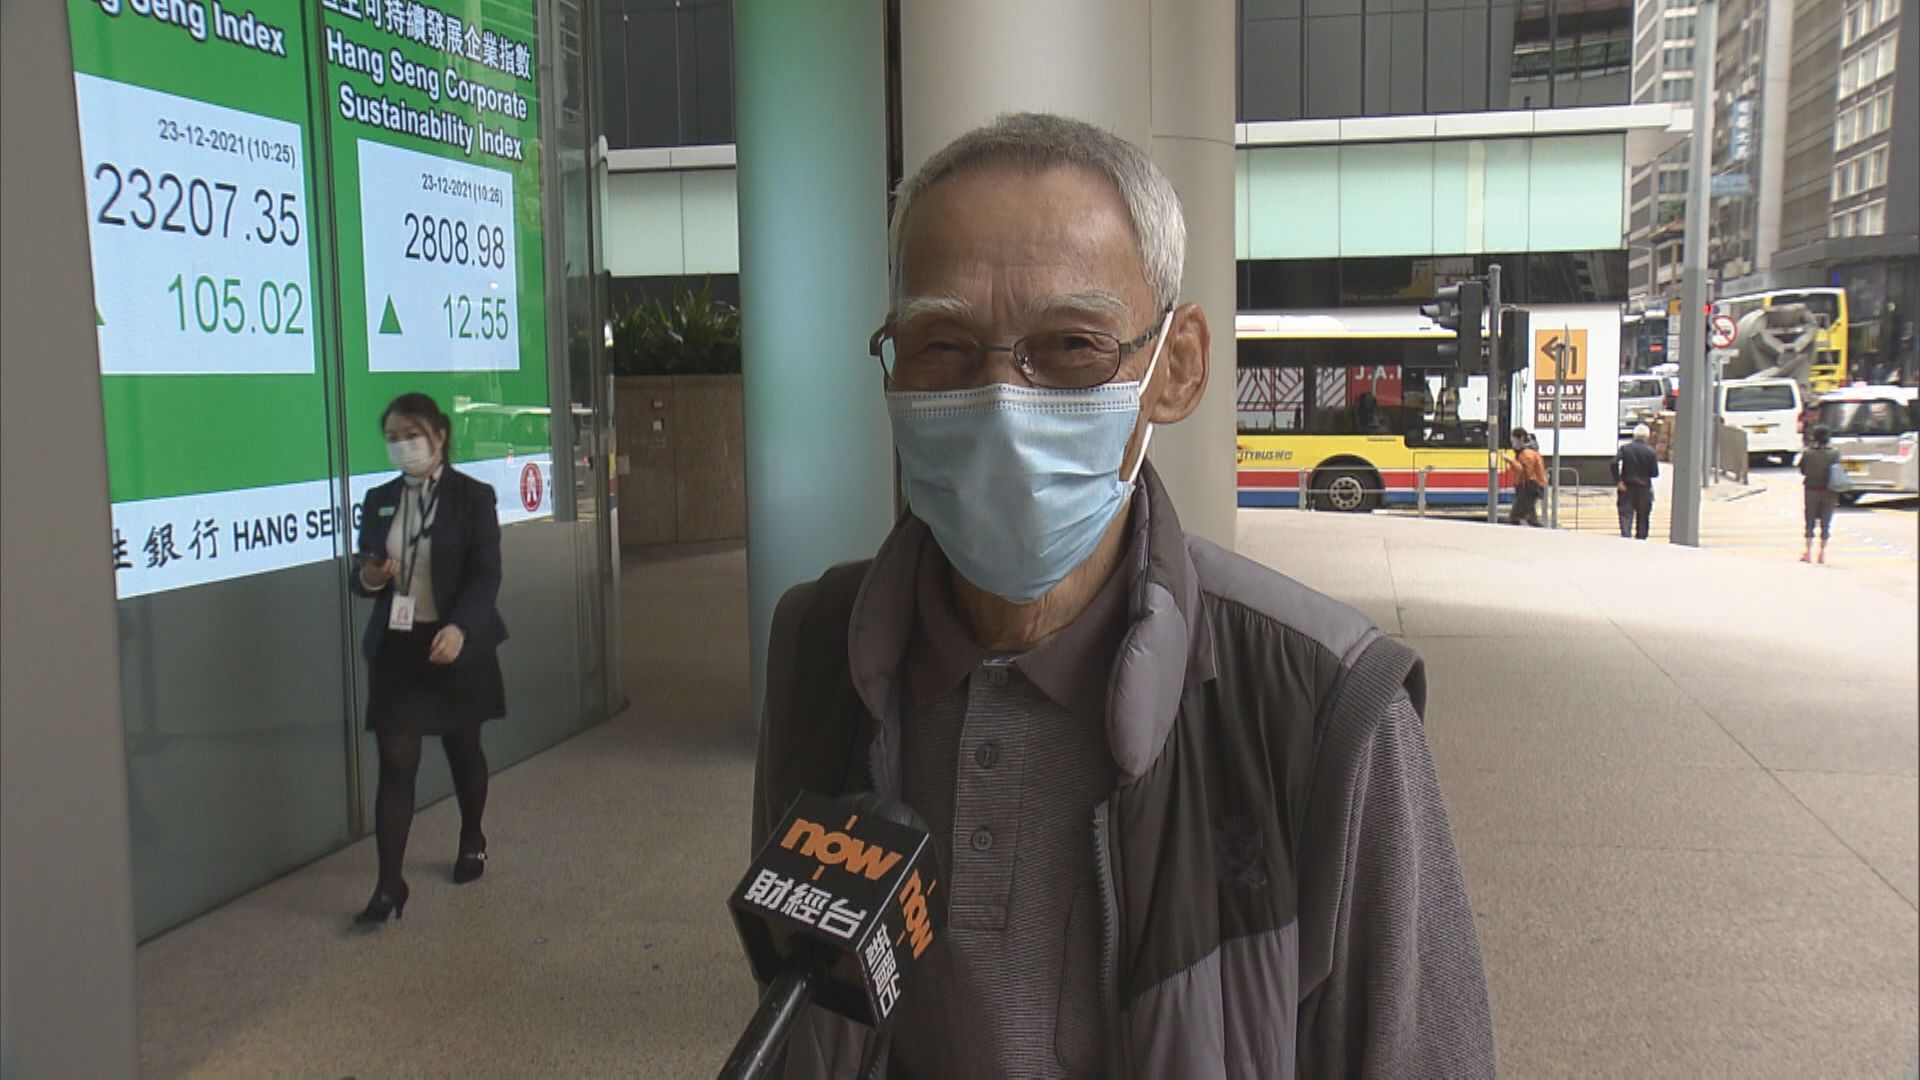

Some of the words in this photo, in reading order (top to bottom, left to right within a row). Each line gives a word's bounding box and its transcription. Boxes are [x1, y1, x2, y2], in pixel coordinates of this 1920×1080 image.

[213, 1, 286, 55] Index
[323, 0, 531, 79] 生可持續發展企業指數
[326, 28, 384, 84] Hang
[390, 49, 440, 100] Seng
[445, 68, 527, 120] Corporate
[340, 84, 473, 155] Sustainability
[479, 123, 522, 160] Index
[95, 163, 300, 245] 23207.35
[404, 212, 505, 269] 2808.98
[168, 273, 304, 334] 105.02
[443, 294, 508, 340] 12.55
[1538, 413, 1582, 422] BUIDING
[233, 513, 298, 552] HANG
[780, 817, 902, 880] now
[744, 868, 867, 939] 財經台
[899, 868, 933, 960] now
[865, 922, 901, 1018] 新聞台
